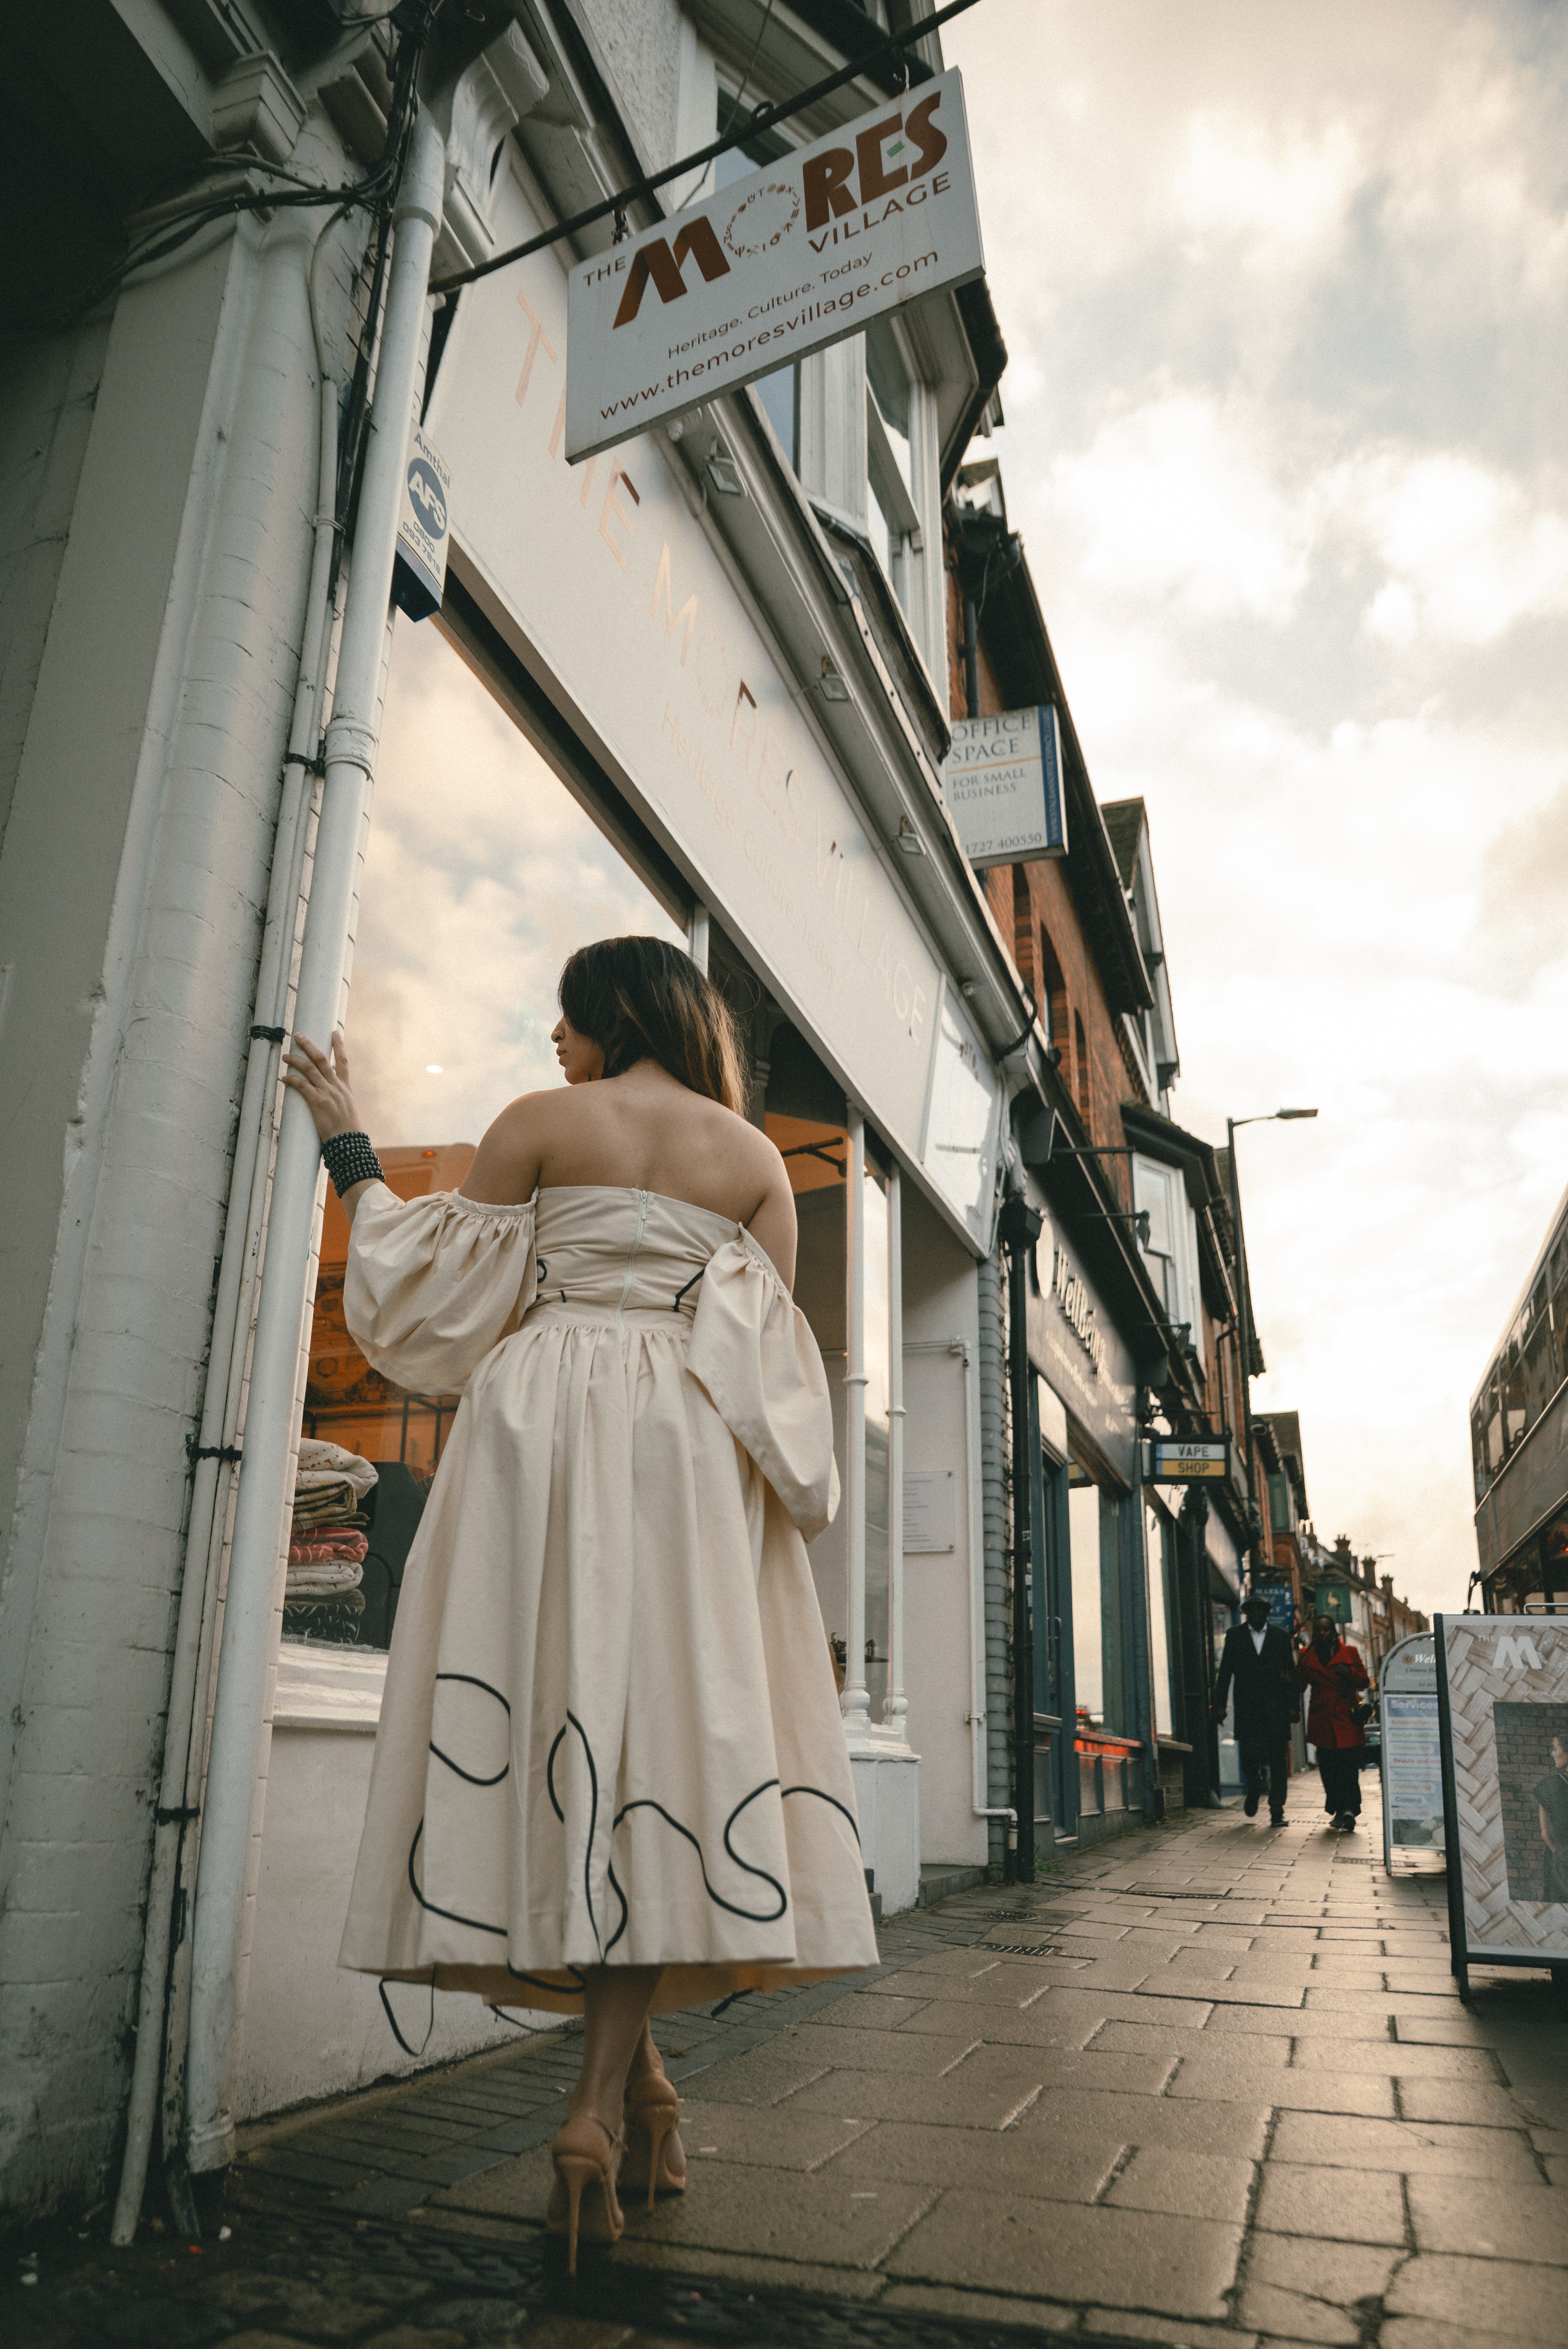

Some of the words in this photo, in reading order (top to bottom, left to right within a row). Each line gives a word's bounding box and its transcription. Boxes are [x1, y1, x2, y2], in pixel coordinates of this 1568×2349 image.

[807, 171, 951, 253] VILLAGE
[583, 255, 626, 286] THE
[667, 317, 743, 359] Heritage.
[747, 282, 815, 319] Culture.
[820, 252, 873, 283] Today
[600, 250, 939, 421] www.themoresvillage.com
[414, 433, 450, 489] Amthal
[408, 471, 446, 531] AFS
[403, 521, 421, 547] 093
[422, 544, 440, 574] 7818
[413, 521, 435, 553] 0800
[952, 714, 1030, 742] OFFICE
[952, 738, 1019, 764] SPACE
[953, 775, 978, 789] FOR
[984, 768, 1026, 783] SMALL
[953, 782, 1017, 801] BUSINESS
[1178, 1445, 1209, 1458] VAPE
[1178, 1462, 1210, 1473] SHOP
